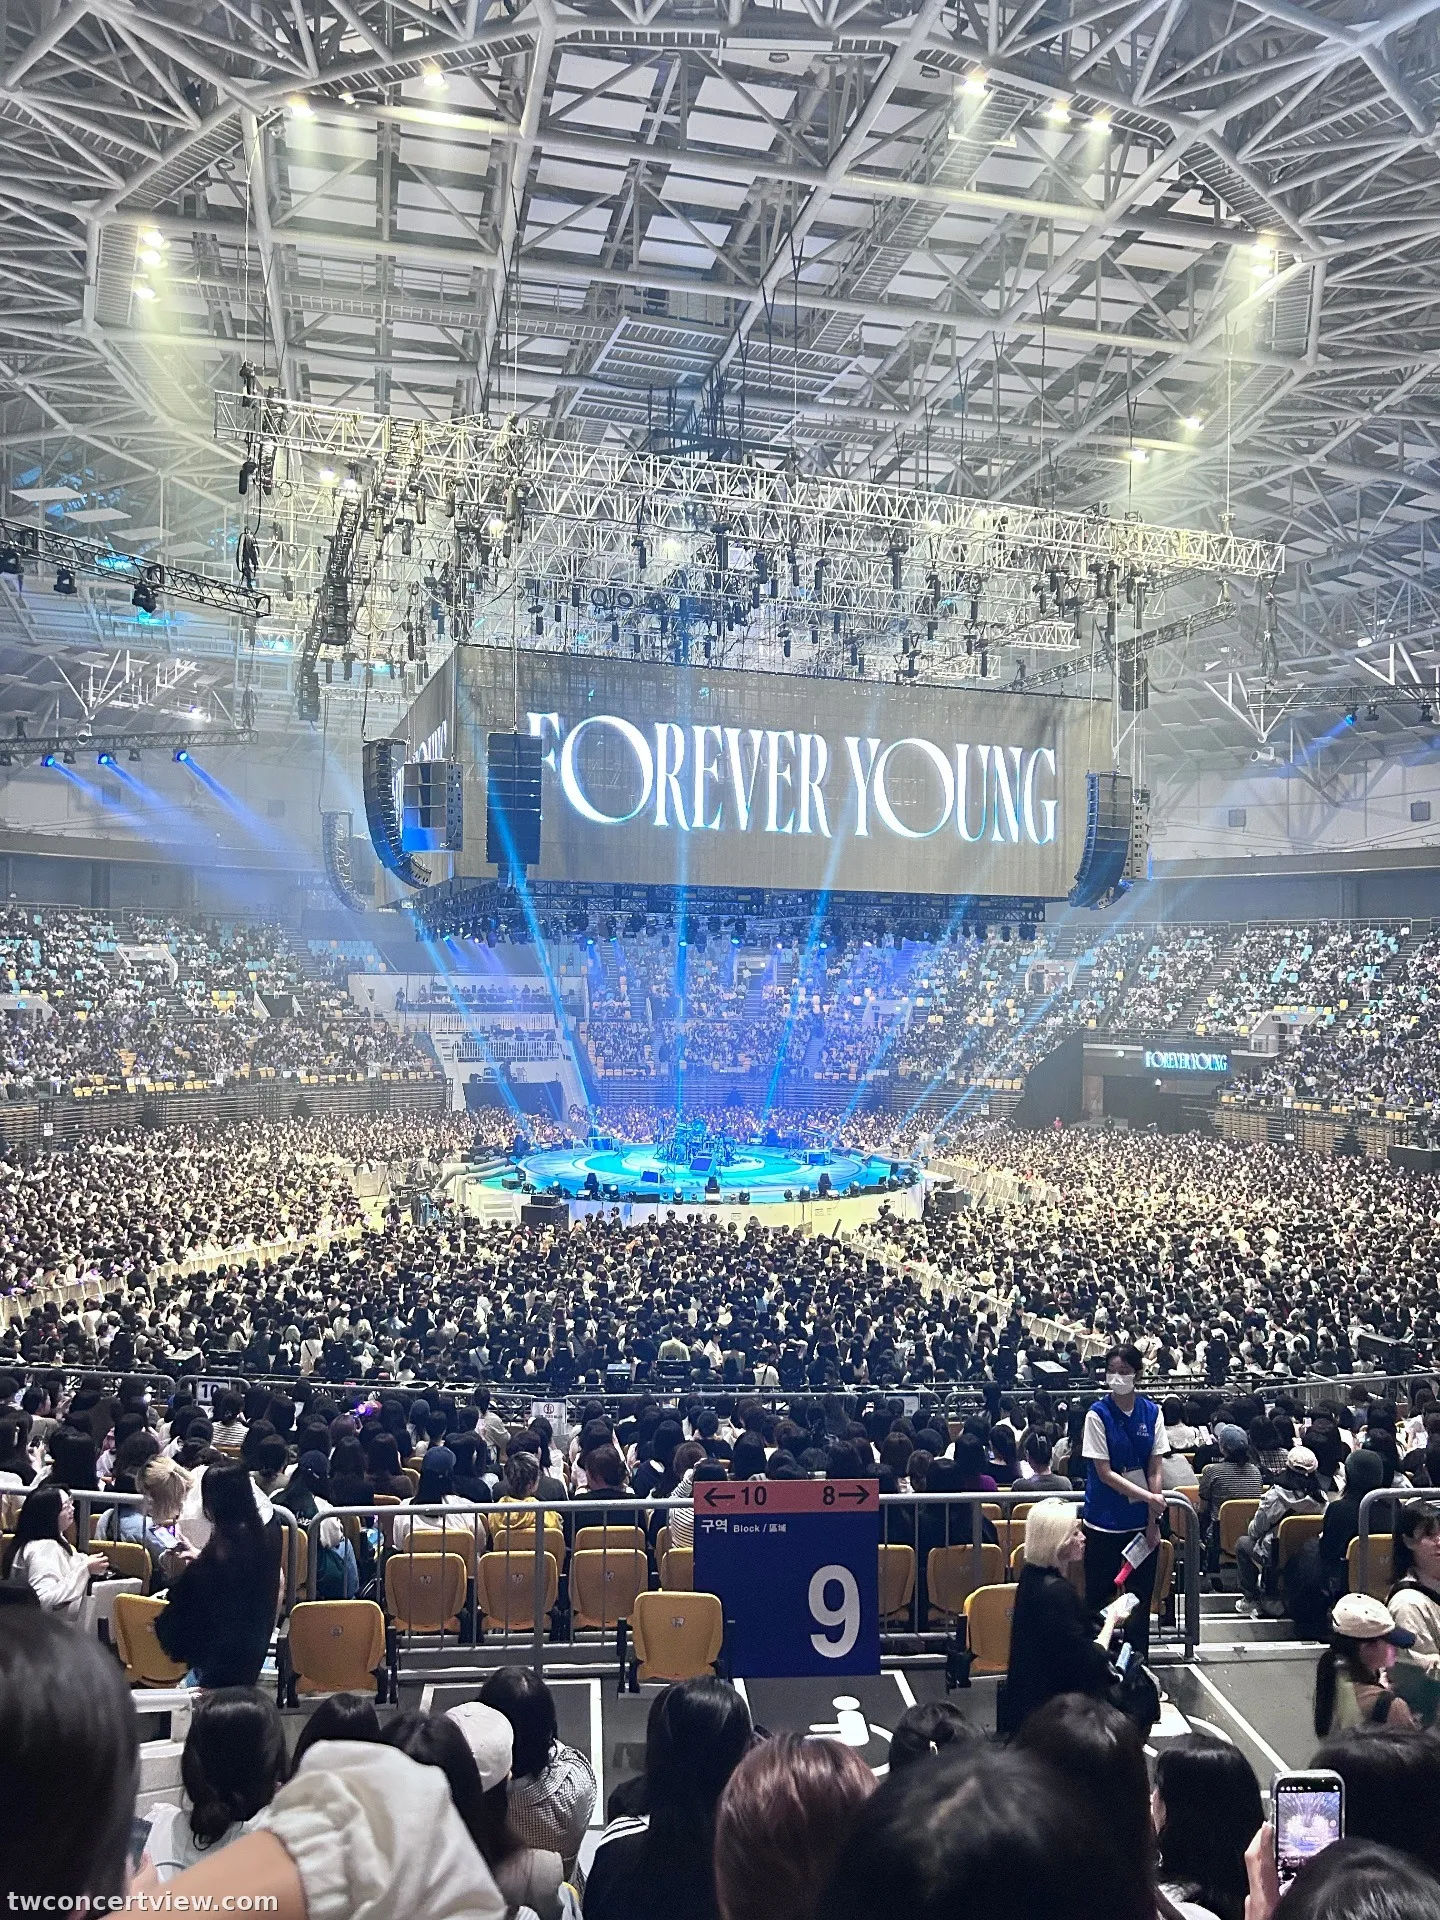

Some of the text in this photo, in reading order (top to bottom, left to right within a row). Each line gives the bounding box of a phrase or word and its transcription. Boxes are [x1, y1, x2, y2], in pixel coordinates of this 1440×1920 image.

[845, 737, 1058, 845] YOUNG
[1145, 1051, 1228, 1071] FOREVER YOUNG
[741, 1485, 767, 1506] 10
[822, 1485, 836, 1506] 8
[701, 1519, 728, 1533] 구역
[733, 1524, 760, 1533] Block
[808, 1564, 861, 1659] 9
